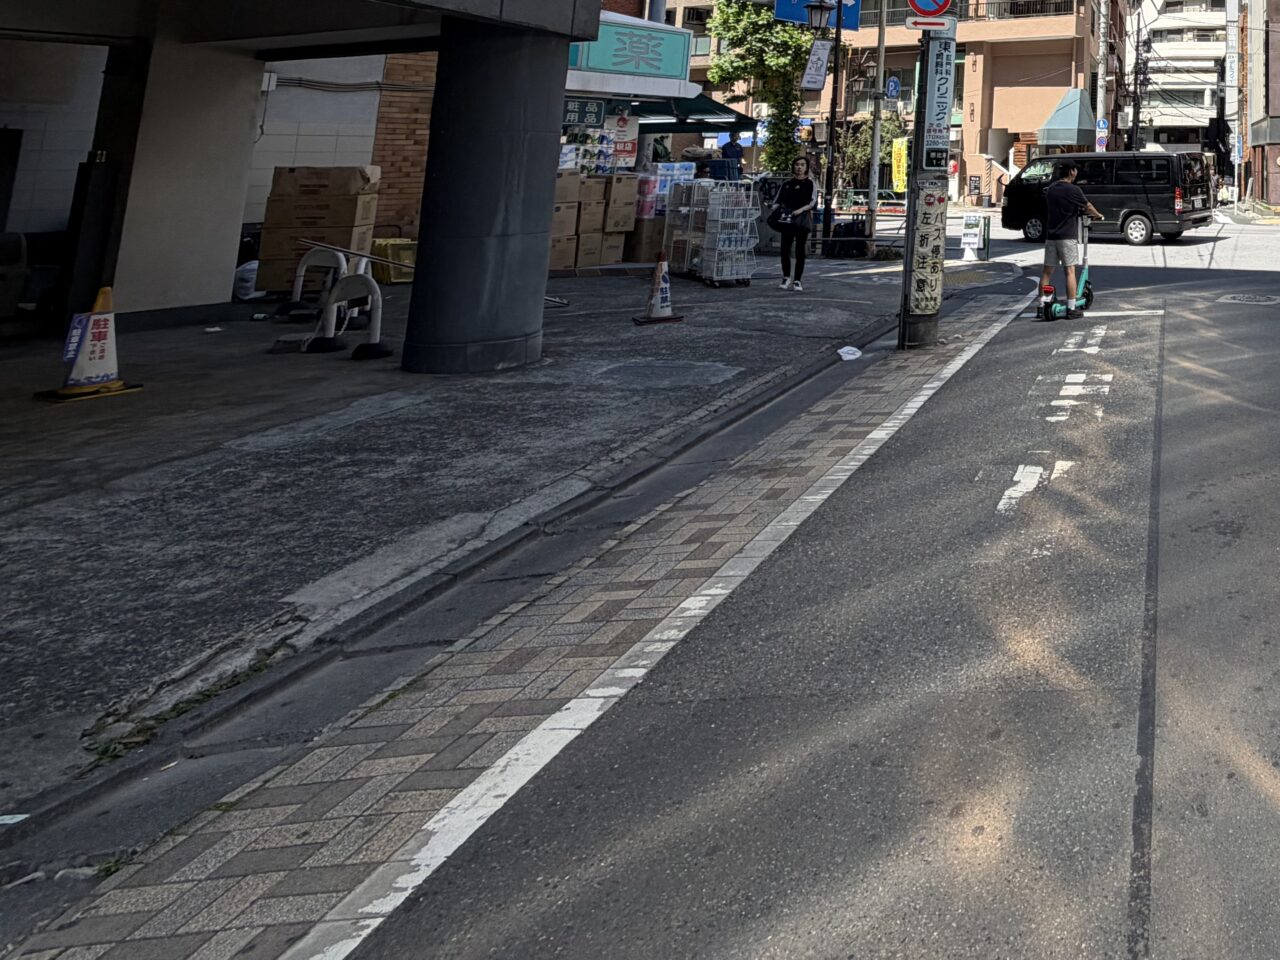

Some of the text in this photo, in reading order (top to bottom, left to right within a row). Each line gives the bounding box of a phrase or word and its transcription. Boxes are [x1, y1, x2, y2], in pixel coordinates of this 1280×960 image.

[611, 31, 665, 71] 薬
[935, 76, 948, 121] クリニック
[931, 211, 945, 292] バス停あり
